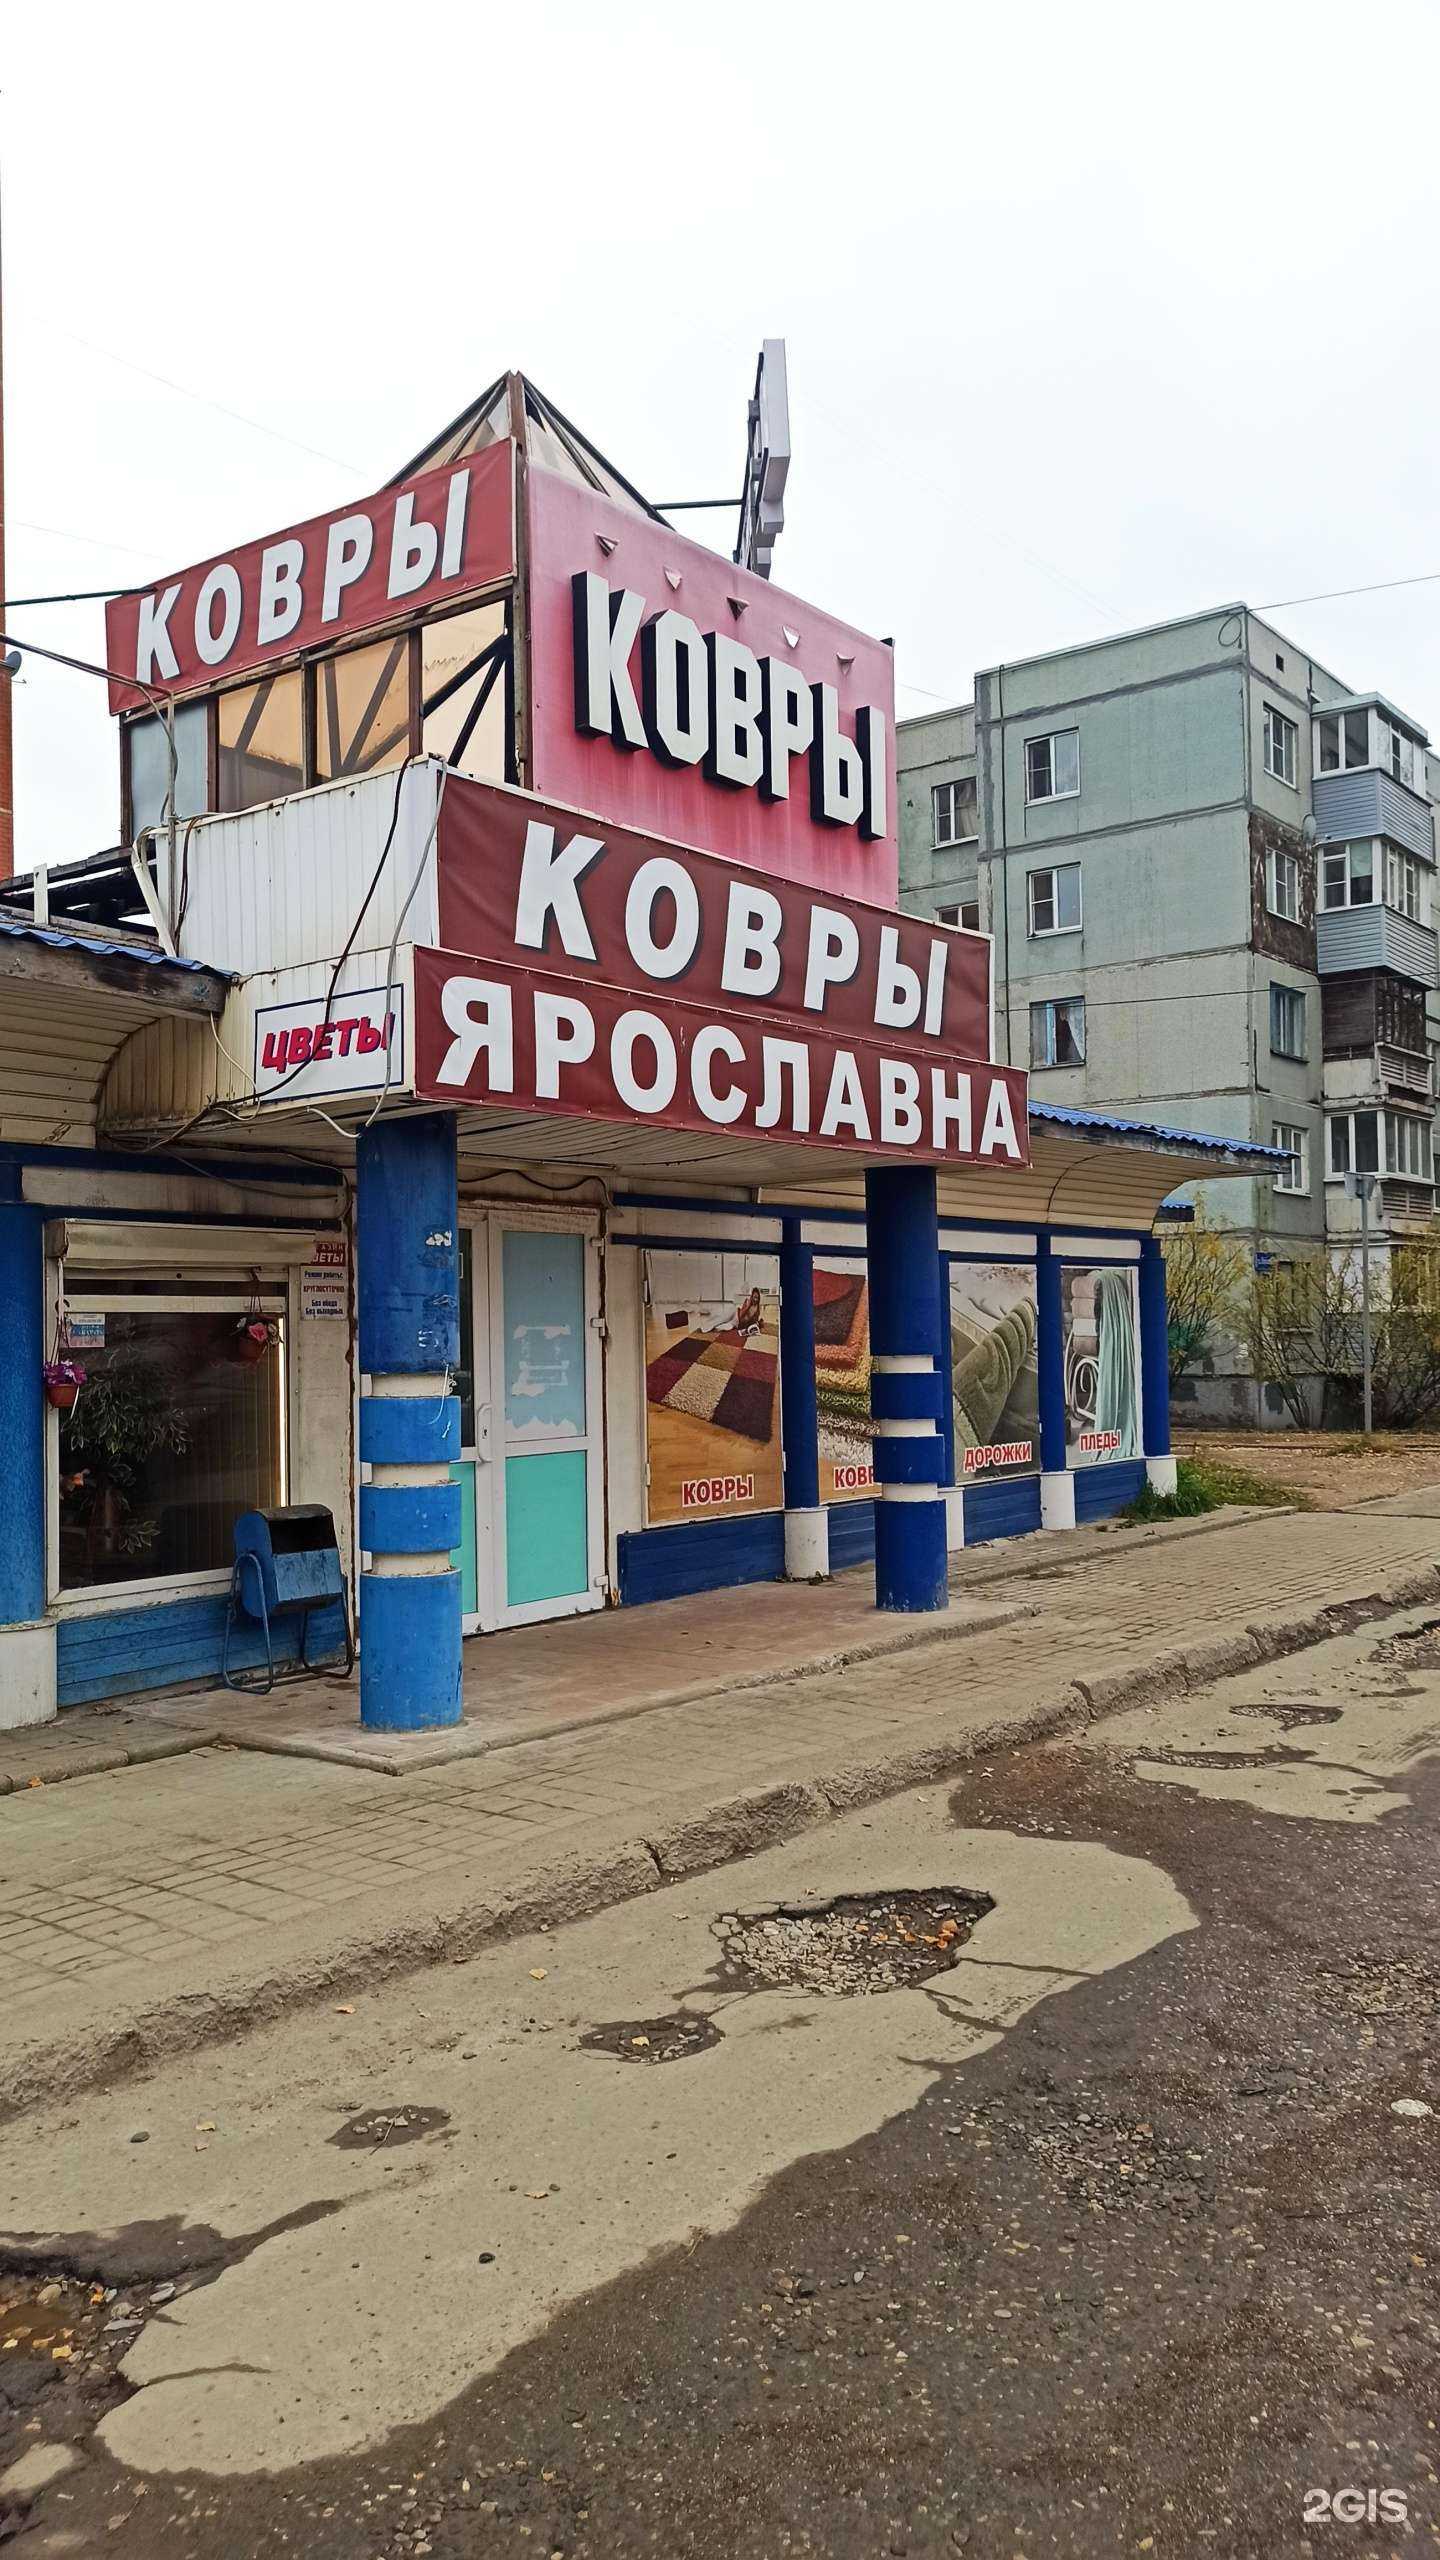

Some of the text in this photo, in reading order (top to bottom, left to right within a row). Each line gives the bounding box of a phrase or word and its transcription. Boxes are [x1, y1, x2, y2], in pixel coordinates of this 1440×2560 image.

[136, 467, 471, 685] КОВРЫ
[572, 570, 887, 841] КОВРЫ
[513, 819, 949, 1037] КОВРЫ
[261, 1011, 396, 1074] ЦВЕТЫ
[435, 975, 1022, 1159] ЯРОСЛАВНА
[683, 1474, 754, 1506] КОВРЫ
[964, 1441, 1032, 1471] ДОРОЖКИ
[1079, 1430, 1121, 1452] ПЛЕДЫ
